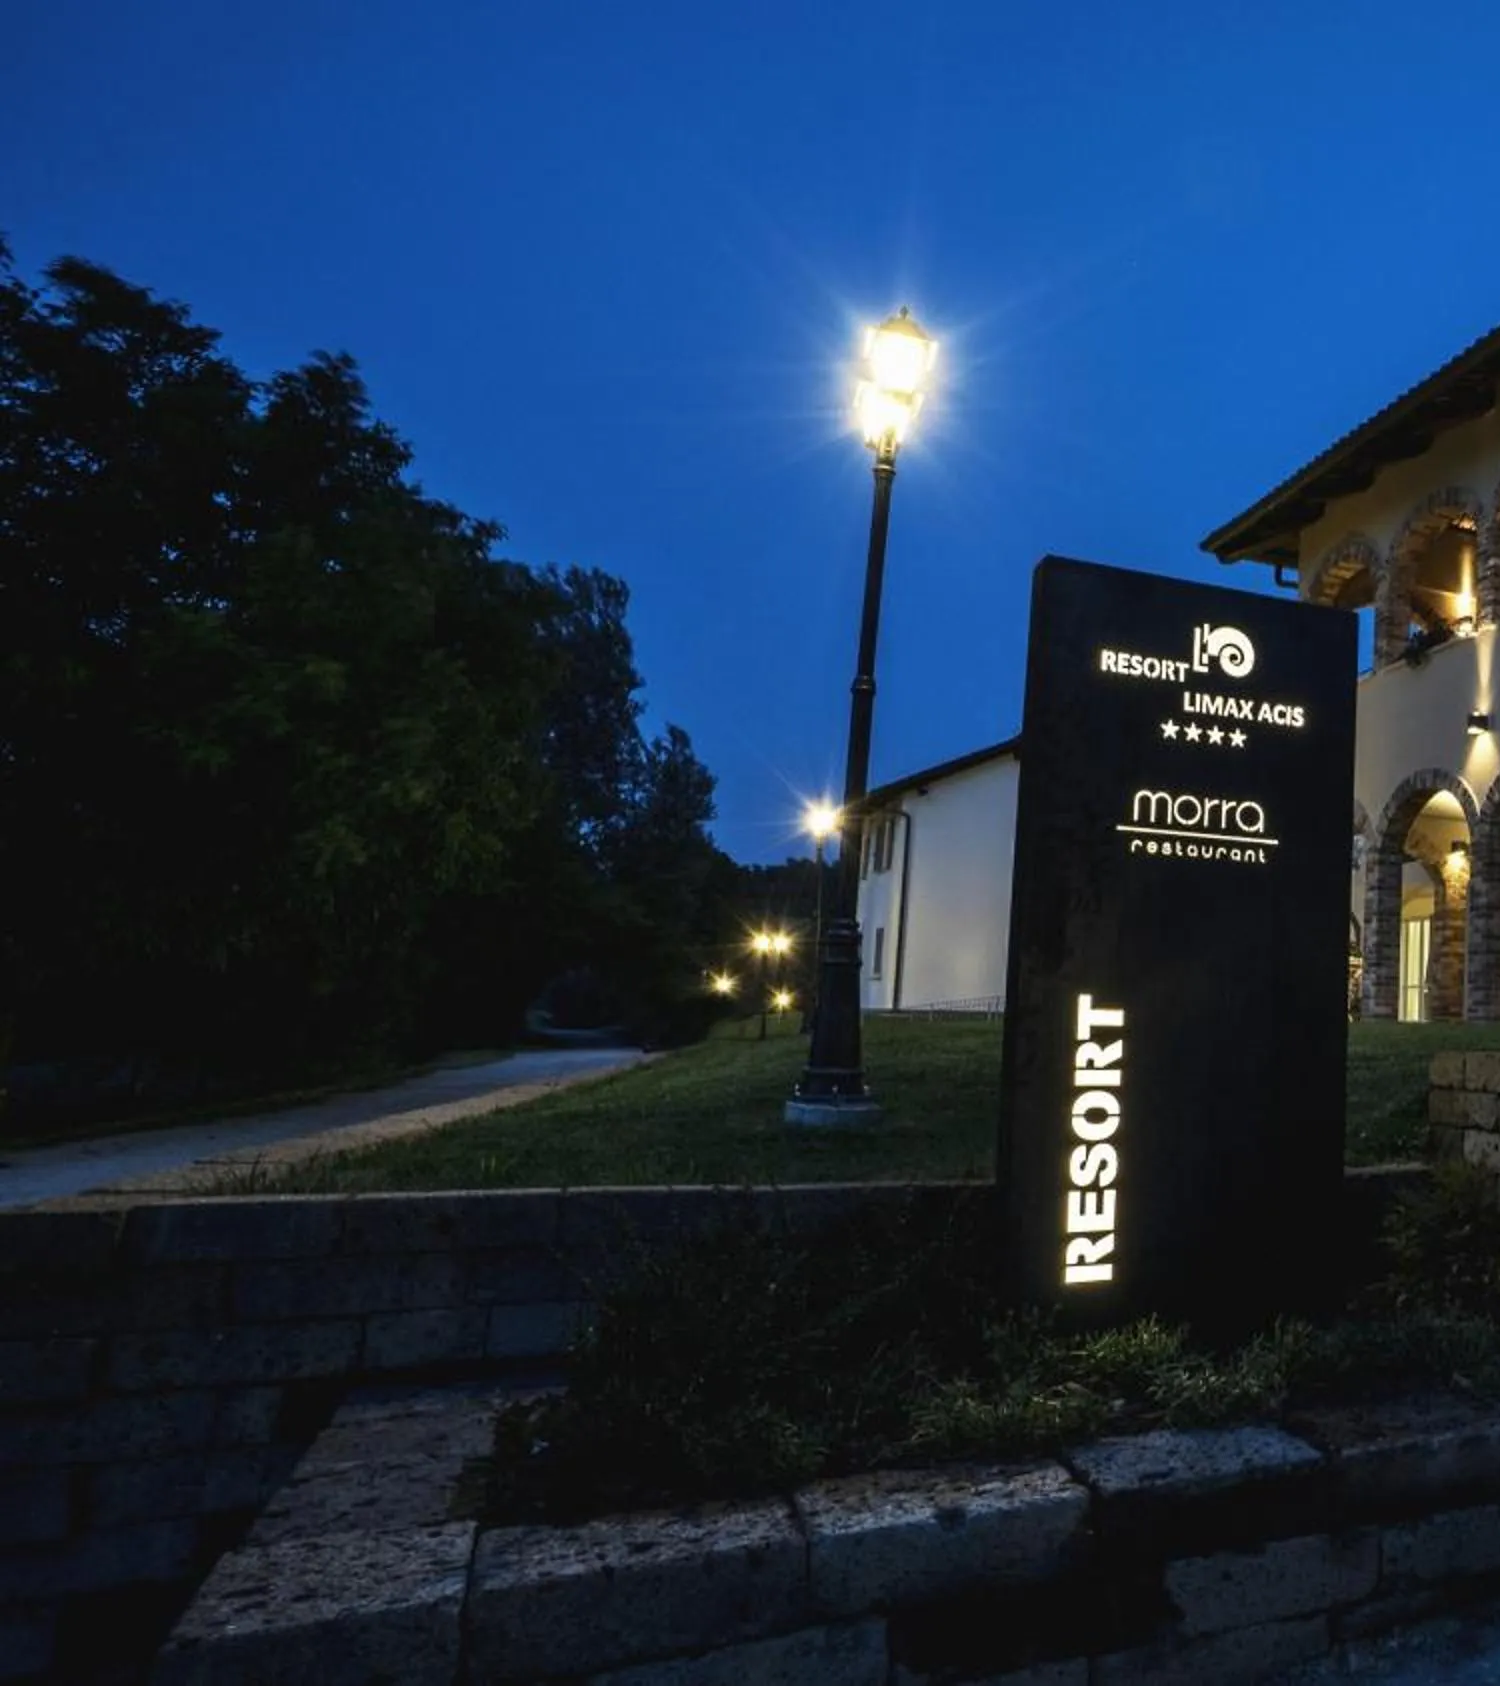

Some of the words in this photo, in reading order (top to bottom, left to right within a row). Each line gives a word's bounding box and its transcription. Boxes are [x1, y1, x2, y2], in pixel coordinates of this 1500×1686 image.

[1099, 648, 1191, 683] RESORT
[1183, 691, 1255, 721] LIMAX
[1257, 701, 1306, 728] ACIS
[1132, 788, 1266, 833] morra
[1130, 839, 1267, 864] restaurant
[1063, 993, 1126, 1286] RESORT
